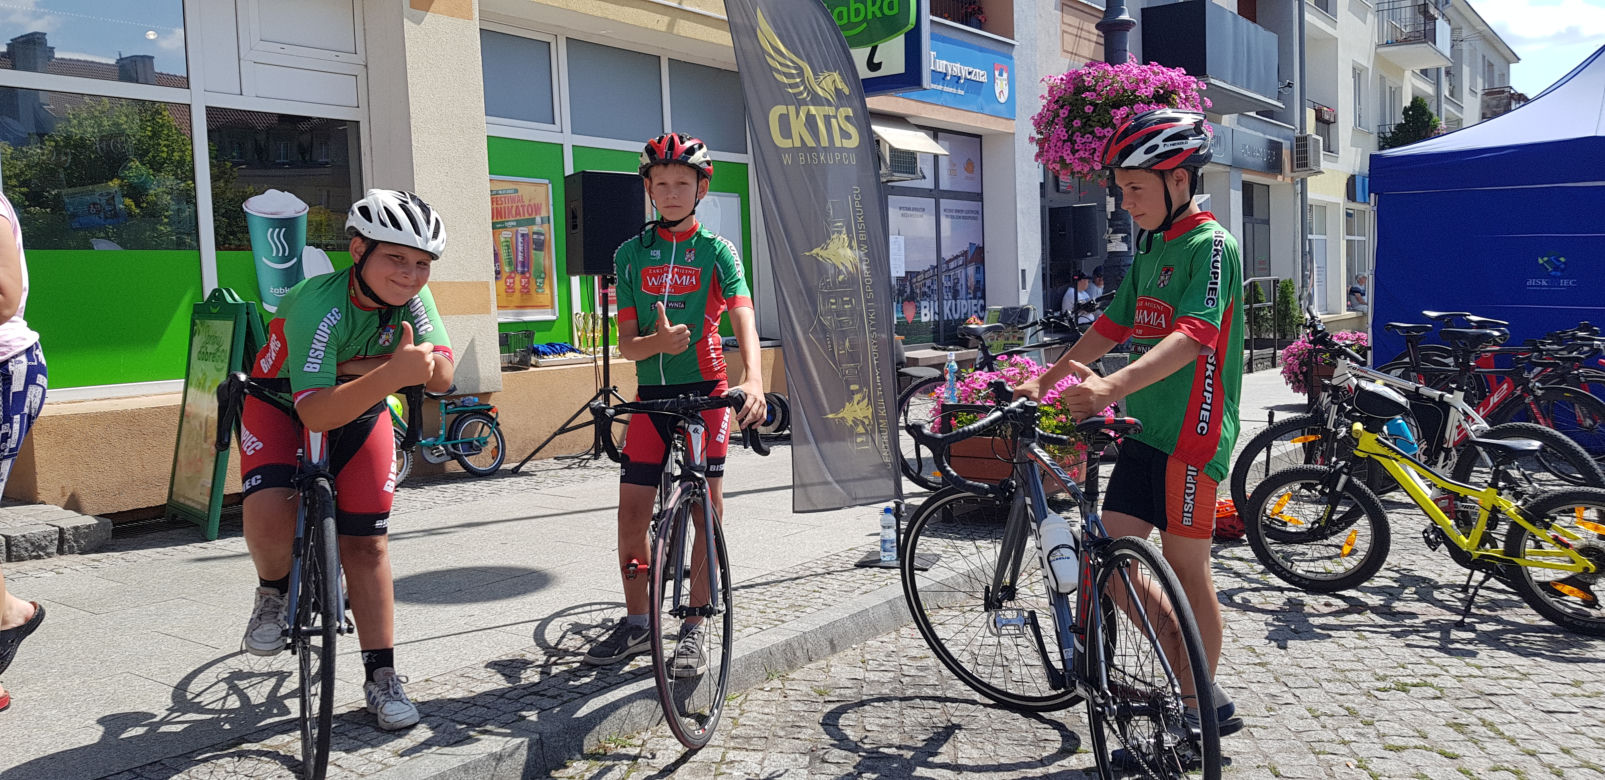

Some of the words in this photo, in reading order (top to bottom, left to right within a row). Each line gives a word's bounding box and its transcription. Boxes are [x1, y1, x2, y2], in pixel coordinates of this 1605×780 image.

[828, 0, 899, 26] abka
[929, 51, 988, 84] Turystyczna
[768, 104, 860, 148] CKTiS
[781, 153, 792, 165] W
[799, 152, 856, 165] BISKUPCU
[853, 186, 867, 241] BISKUPCU
[862, 256, 874, 299] SPORTU
[303, 307, 342, 373] BISKUPIEC
